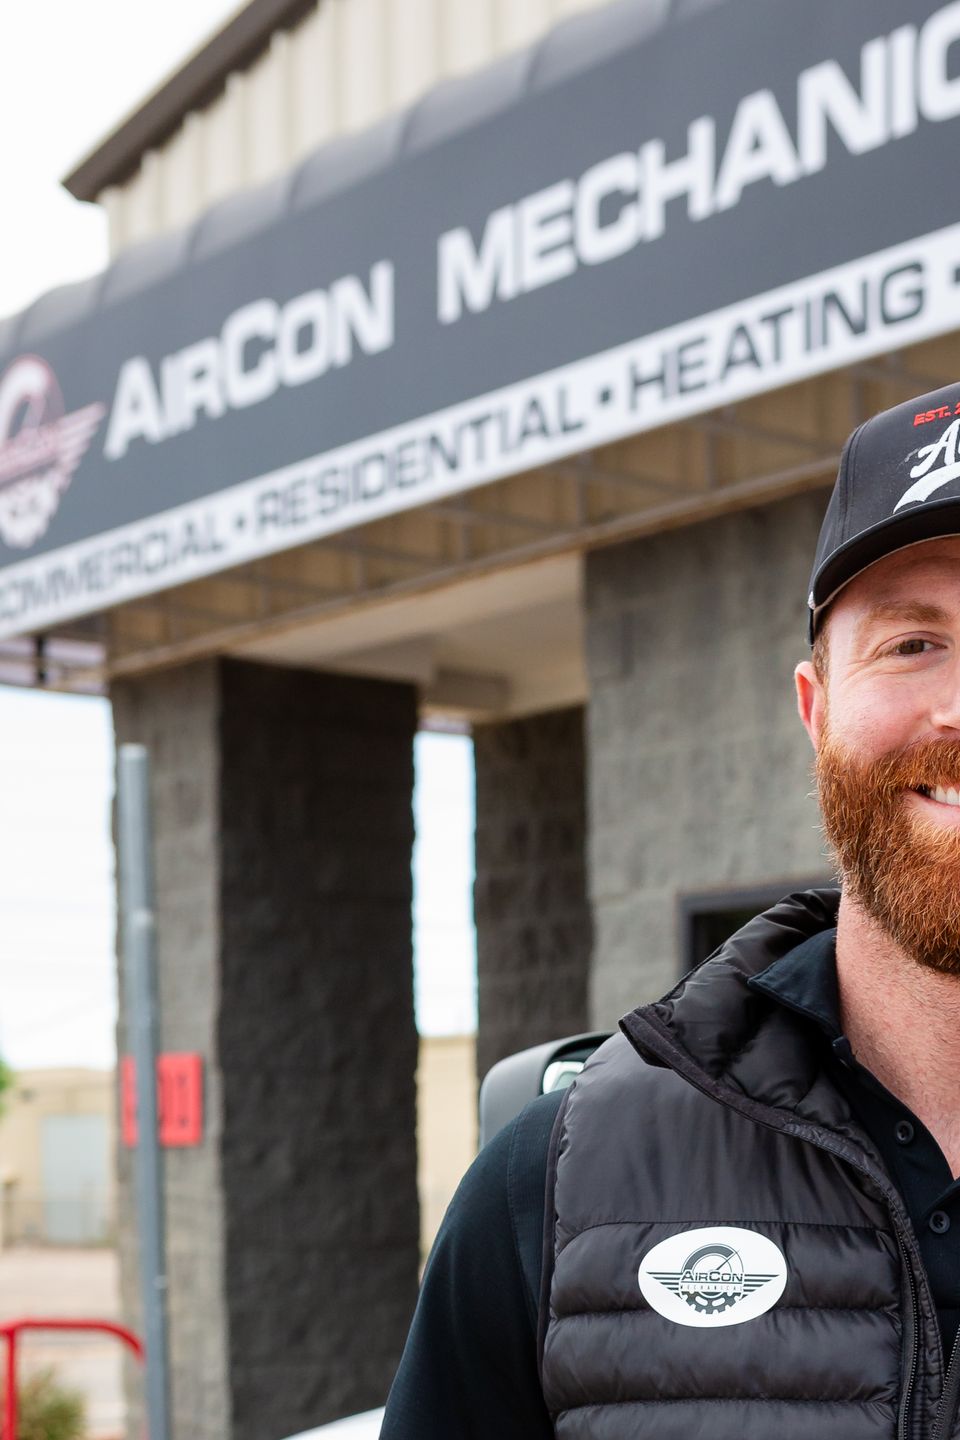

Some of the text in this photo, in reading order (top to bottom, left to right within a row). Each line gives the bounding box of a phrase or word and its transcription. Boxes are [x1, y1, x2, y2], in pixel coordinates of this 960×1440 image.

[0, 512, 226, 620] OMMERCIAL
[255, 386, 588, 538] RESIDENTIAL
[627, 260, 926, 413] HEATING
[913, 406, 951, 427] EST.
